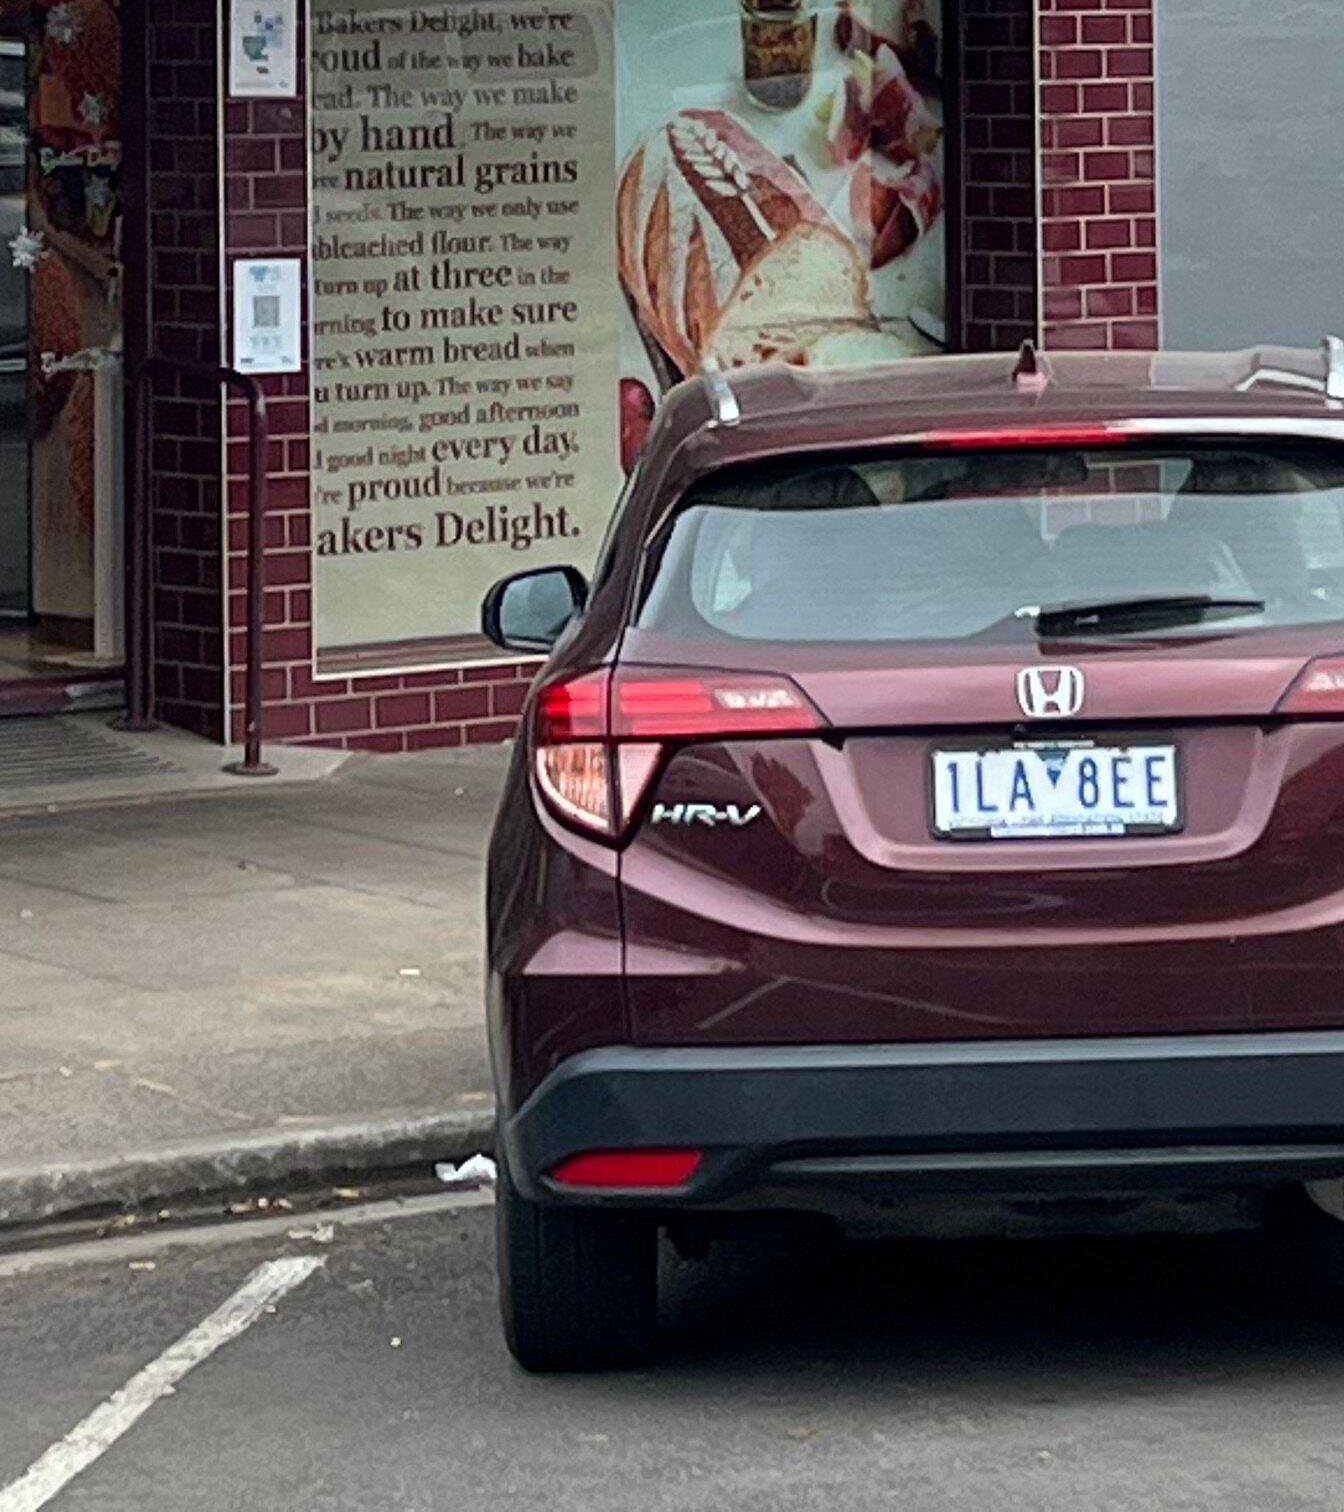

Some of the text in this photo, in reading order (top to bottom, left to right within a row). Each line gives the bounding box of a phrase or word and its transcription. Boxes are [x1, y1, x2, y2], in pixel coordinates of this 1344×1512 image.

[316, 8, 402, 35] Bakers
[510, 6, 574, 31] we're
[388, 52, 406, 70] of
[411, 50, 442, 70] the
[487, 52, 514, 69] we
[518, 43, 575, 68] bake
[367, 84, 413, 108] The
[420, 89, 464, 113] way
[473, 89, 506, 106] we
[512, 79, 579, 106] make
[470, 121, 506, 141] The
[510, 123, 548, 143] way
[552, 123, 577, 139] we
[344, 154, 466, 190] natural
[474, 151, 579, 193] grains
[386, 201, 425, 222] The
[429, 202, 468, 223] way
[471, 202, 498, 218] we
[501, 196, 542, 220] only
[546, 198, 579, 215] use
[431, 229, 495, 257] flour.
[500, 233, 534, 252] The
[537, 235, 574, 254] way
[364, 277, 388, 298] up
[393, 265, 421, 291] at
[431, 258, 513, 290] three
[518, 268, 536, 286] in
[541, 264, 571, 285] the
[381, 305, 411, 332] to
[420, 297, 504, 330] make
[511, 300, 579, 326] sure
[355, 344, 435, 369] warm
[443, 333, 520, 364] bread
[525, 338, 576, 358] when
[335, 380, 390, 403] turn
[436, 375, 472, 397] The
[475, 379, 512, 397] way
[515, 378, 542, 391] we
[545, 375, 575, 394] say
[418, 403, 471, 433] good
[475, 401, 581, 424] afternoon
[326, 446, 374, 473] good
[378, 444, 428, 469] night
[431, 434, 516, 466] every
[522, 424, 580, 461] day.
[347, 466, 443, 511] proud
[446, 473, 523, 496] because
[525, 470, 576, 489] we're
[435, 501, 581, 551] Delight.
[947, 755, 1168, 813] 1LA 8EE
[651, 803, 761, 827] HR-V
